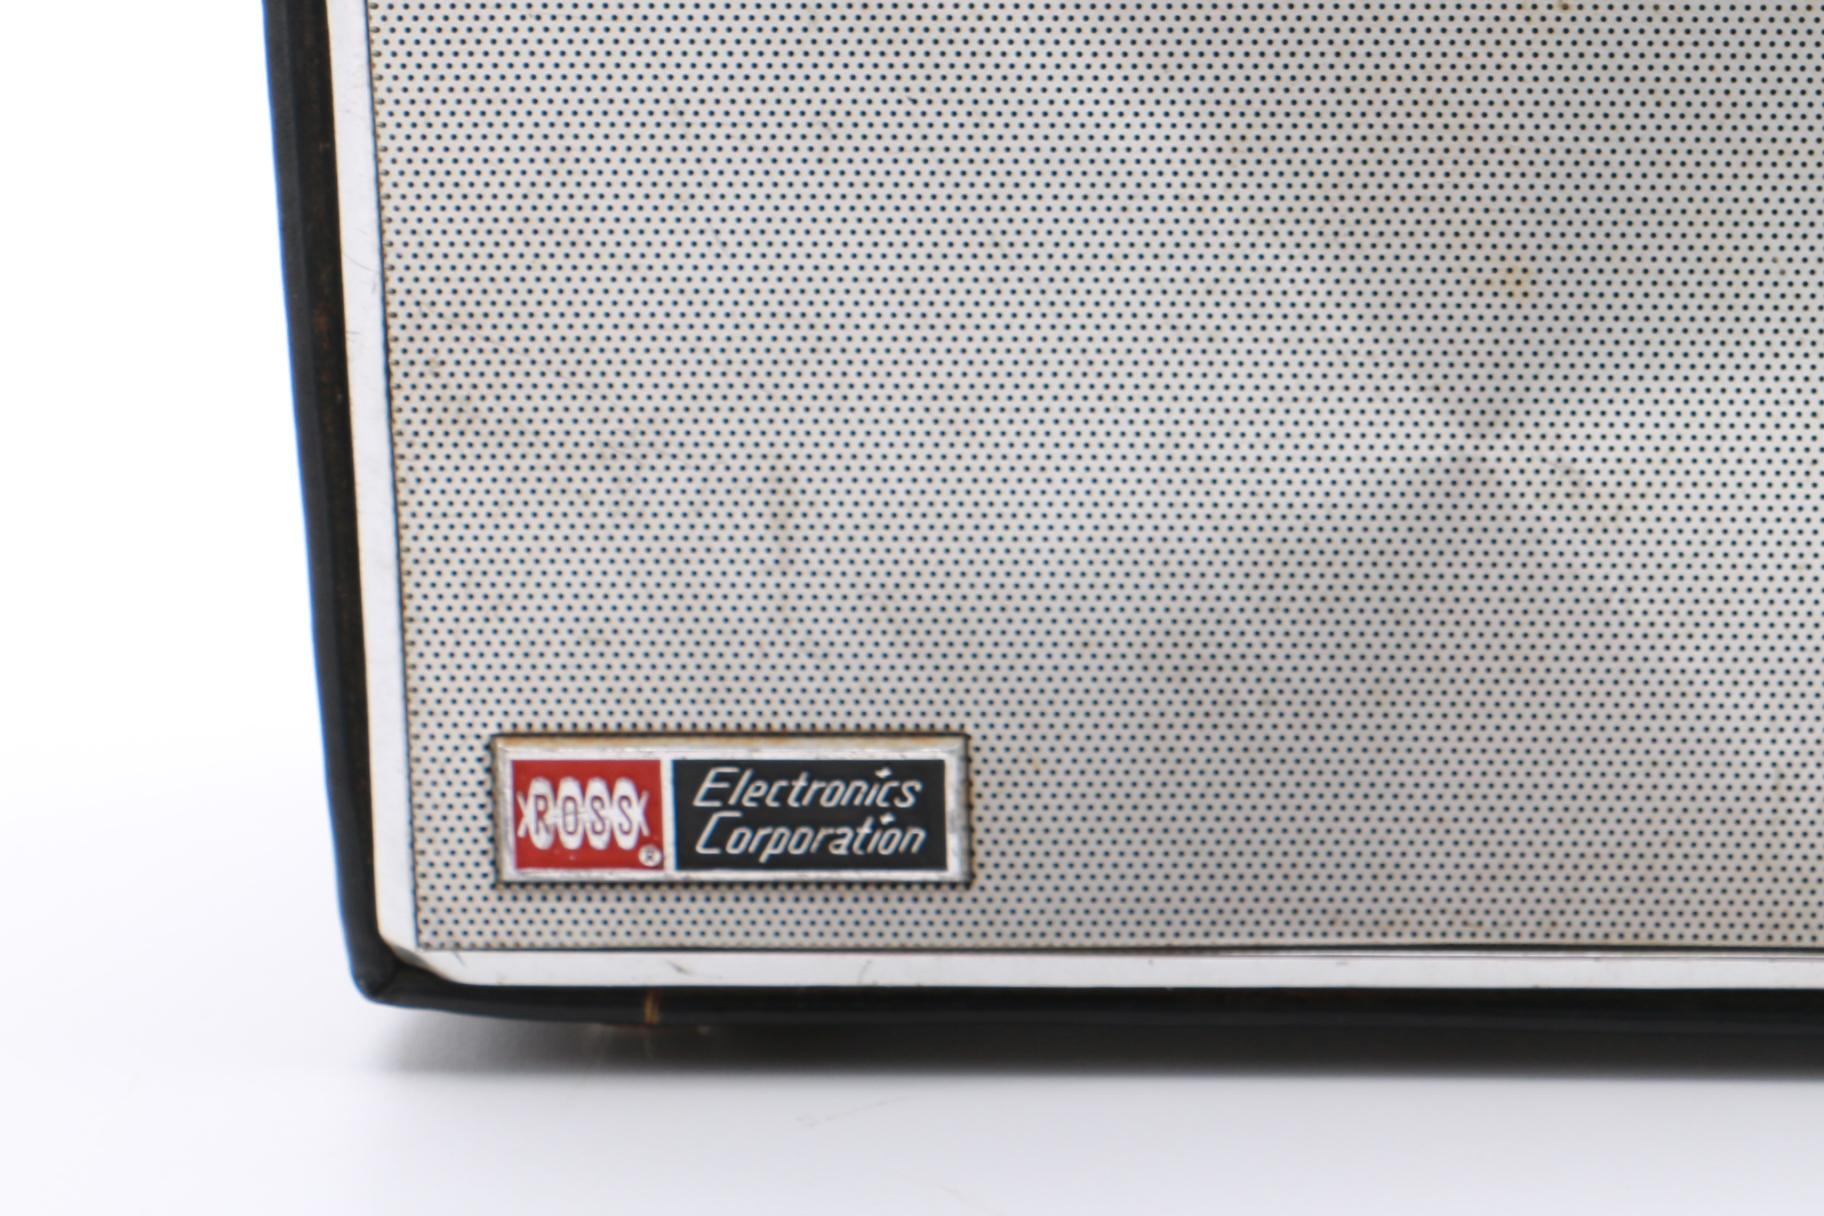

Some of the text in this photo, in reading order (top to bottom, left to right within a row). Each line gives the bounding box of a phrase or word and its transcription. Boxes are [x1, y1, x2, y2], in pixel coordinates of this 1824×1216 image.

[693, 767, 922, 808] Electronics
[530, 793, 634, 835] ROSS
[696, 811, 926, 862] Corporation
